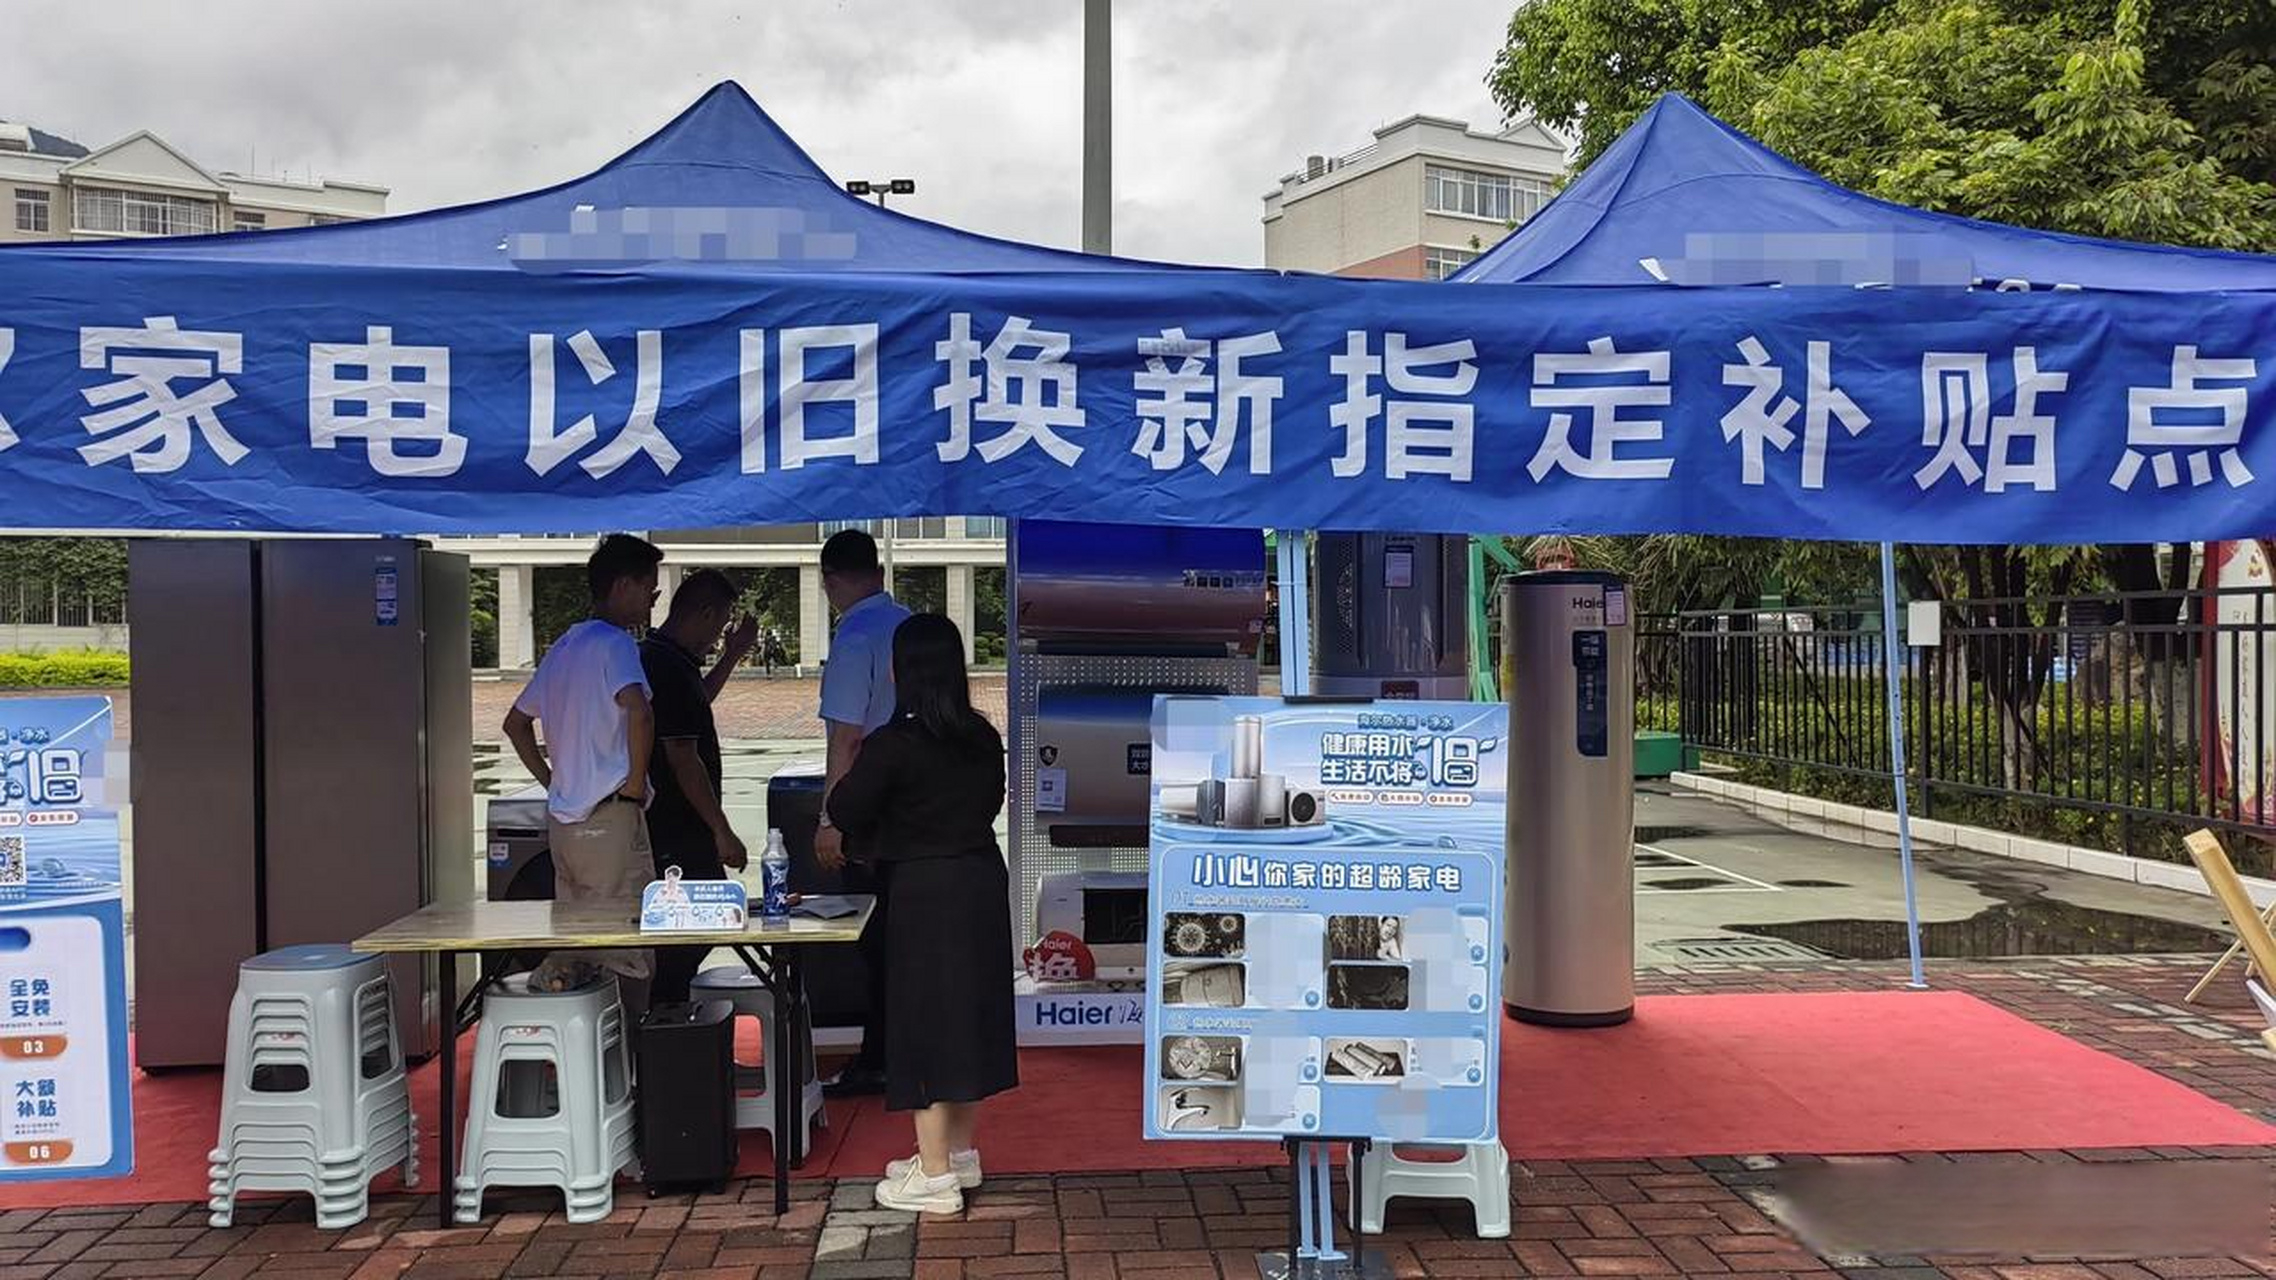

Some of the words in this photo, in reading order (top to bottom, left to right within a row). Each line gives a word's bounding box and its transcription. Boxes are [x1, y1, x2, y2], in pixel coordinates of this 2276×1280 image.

[1572, 596, 1605, 609] Haie
[1322, 733, 1414, 759] 健康用水
[1321, 759, 1414, 784] 生活不将
[1193, 854, 1462, 892] 小心你家的超龄家电
[10, 978, 51, 998] 全免
[11, 999, 51, 1018] 安装
[1036, 1000, 1113, 1026] Haier
[23, 1040, 44, 1054] 03
[15, 1078, 56, 1098] 大额
[17, 1099, 57, 1119] 补贴
[29, 1145, 50, 1159] 06
